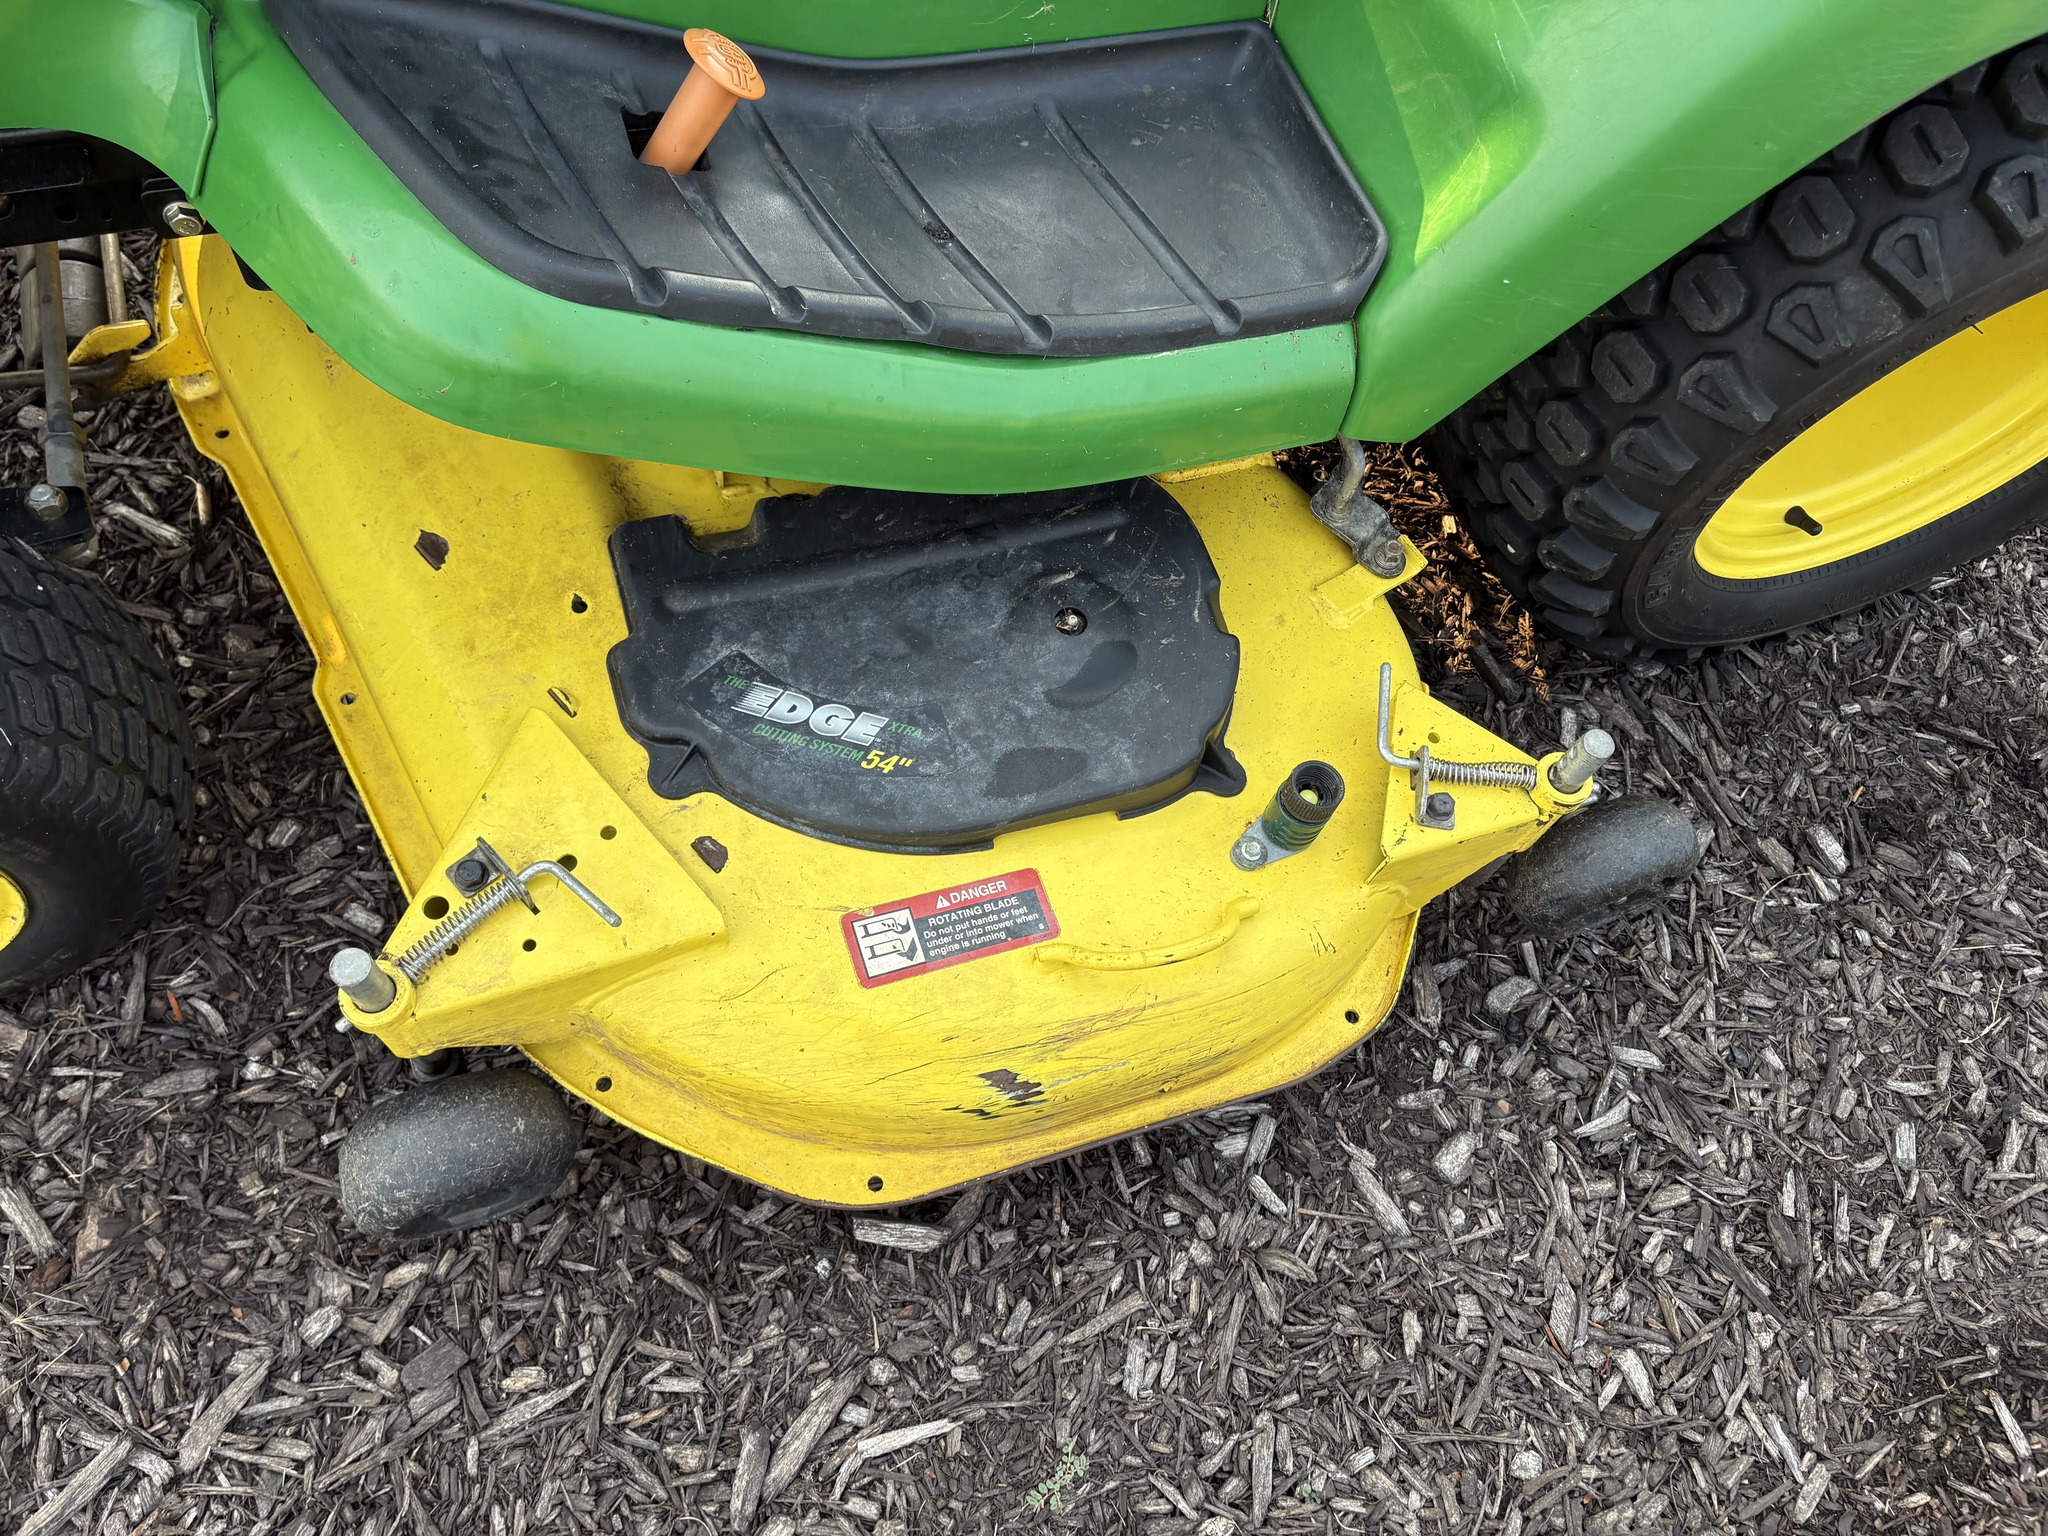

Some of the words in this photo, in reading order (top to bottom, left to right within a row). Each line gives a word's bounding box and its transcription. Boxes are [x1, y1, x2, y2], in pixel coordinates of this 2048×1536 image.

[723, 674, 749, 690] THE
[730, 681, 889, 747] EDGE
[752, 723, 807, 747] CUTTING
[809, 738, 864, 762] SYSTEM
[888, 720, 923, 739] XTRA
[860, 749, 914, 774] 54"
[949, 880, 1007, 904] DANGER
[923, 929, 938, 940] Do
[938, 925, 954, 937] not
[955, 921, 971, 935] put
[971, 913, 999, 927] hands
[1000, 911, 1010, 920] or
[1010, 905, 1028, 918] feet
[928, 905, 983, 928] ROTATING
[983, 896, 1019, 913] BLADE
[926, 937, 953, 949] under
[954, 933, 965, 942] or
[965, 928, 984, 939] into
[983, 920, 1013, 935] mower
[1014, 911, 1040, 925] when
[929, 941, 959, 957] engine
[961, 938, 971, 948] is
[971, 929, 1007, 947] running
